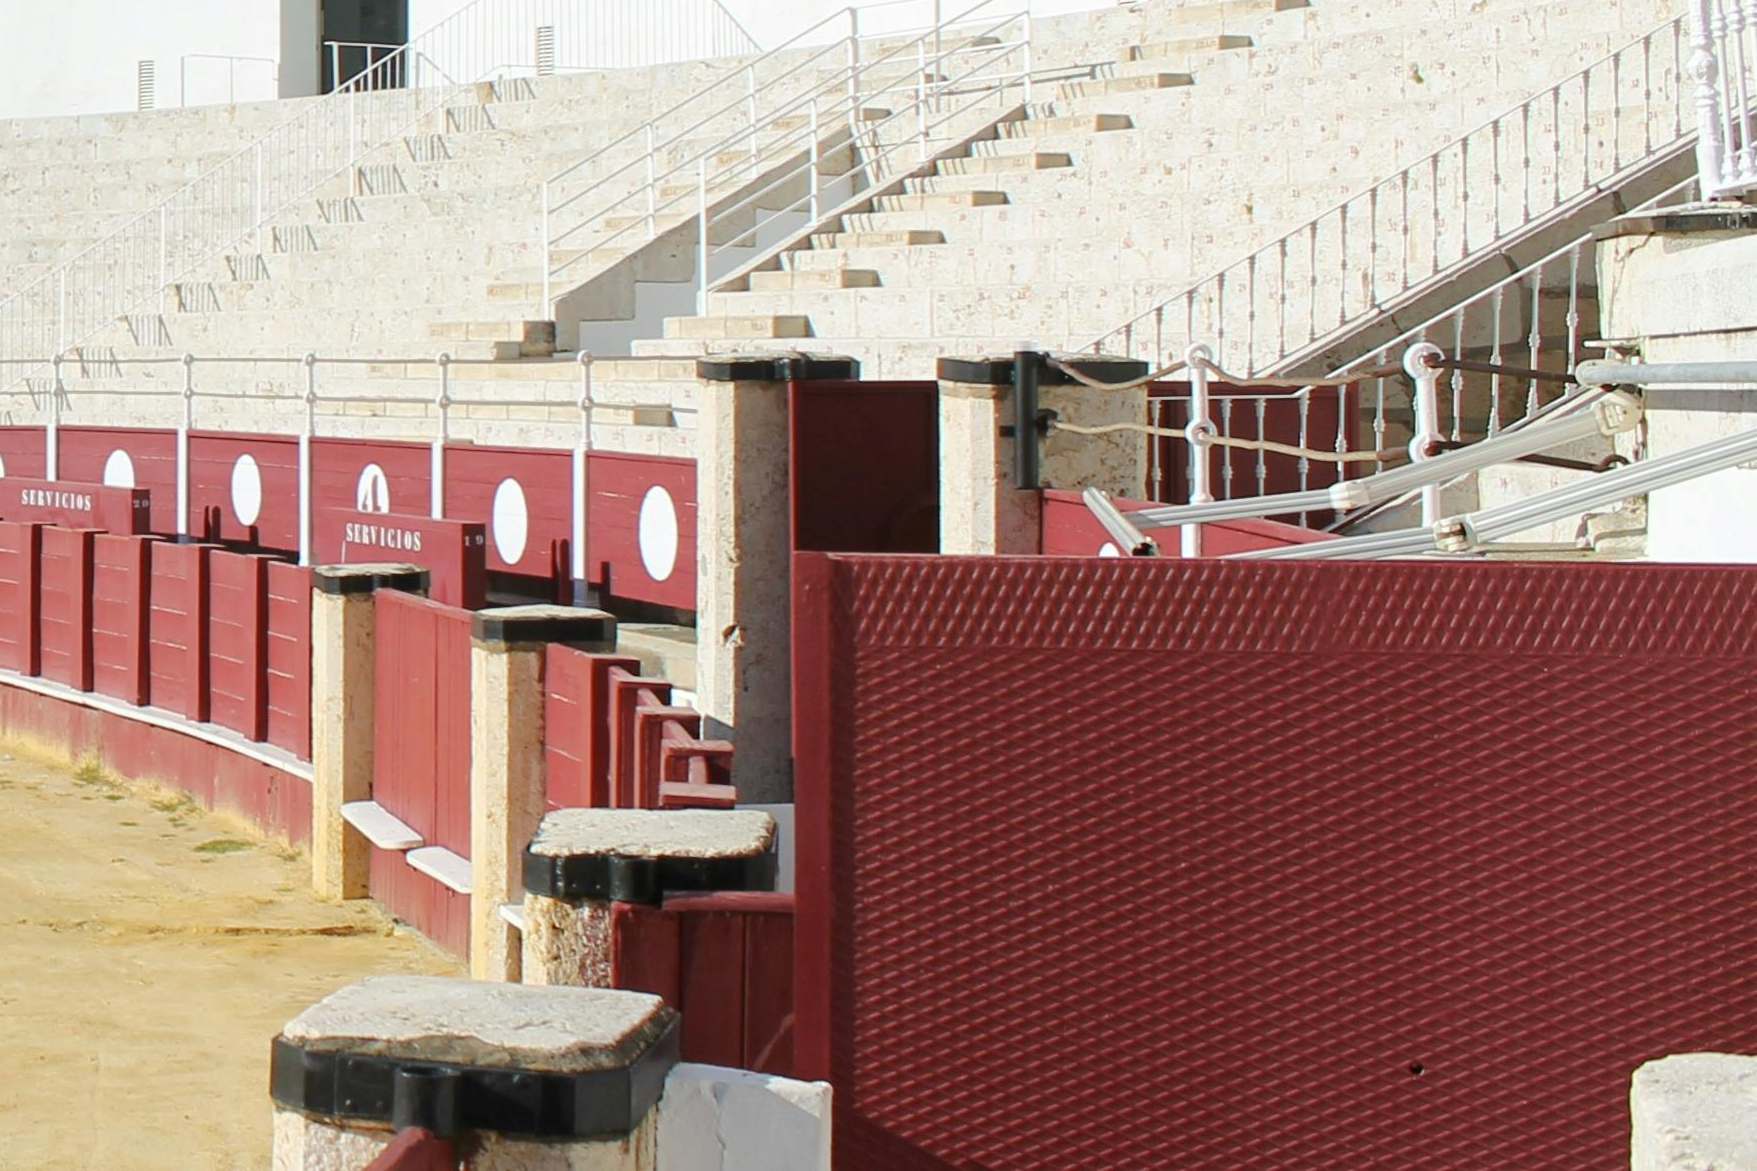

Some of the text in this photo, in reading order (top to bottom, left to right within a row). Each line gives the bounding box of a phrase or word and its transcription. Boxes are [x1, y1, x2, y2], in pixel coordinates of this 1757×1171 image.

[21, 488, 91, 511] SERVICIOS
[346, 523, 421, 552] SERVICIOS
[464, 534, 484, 547] 19
